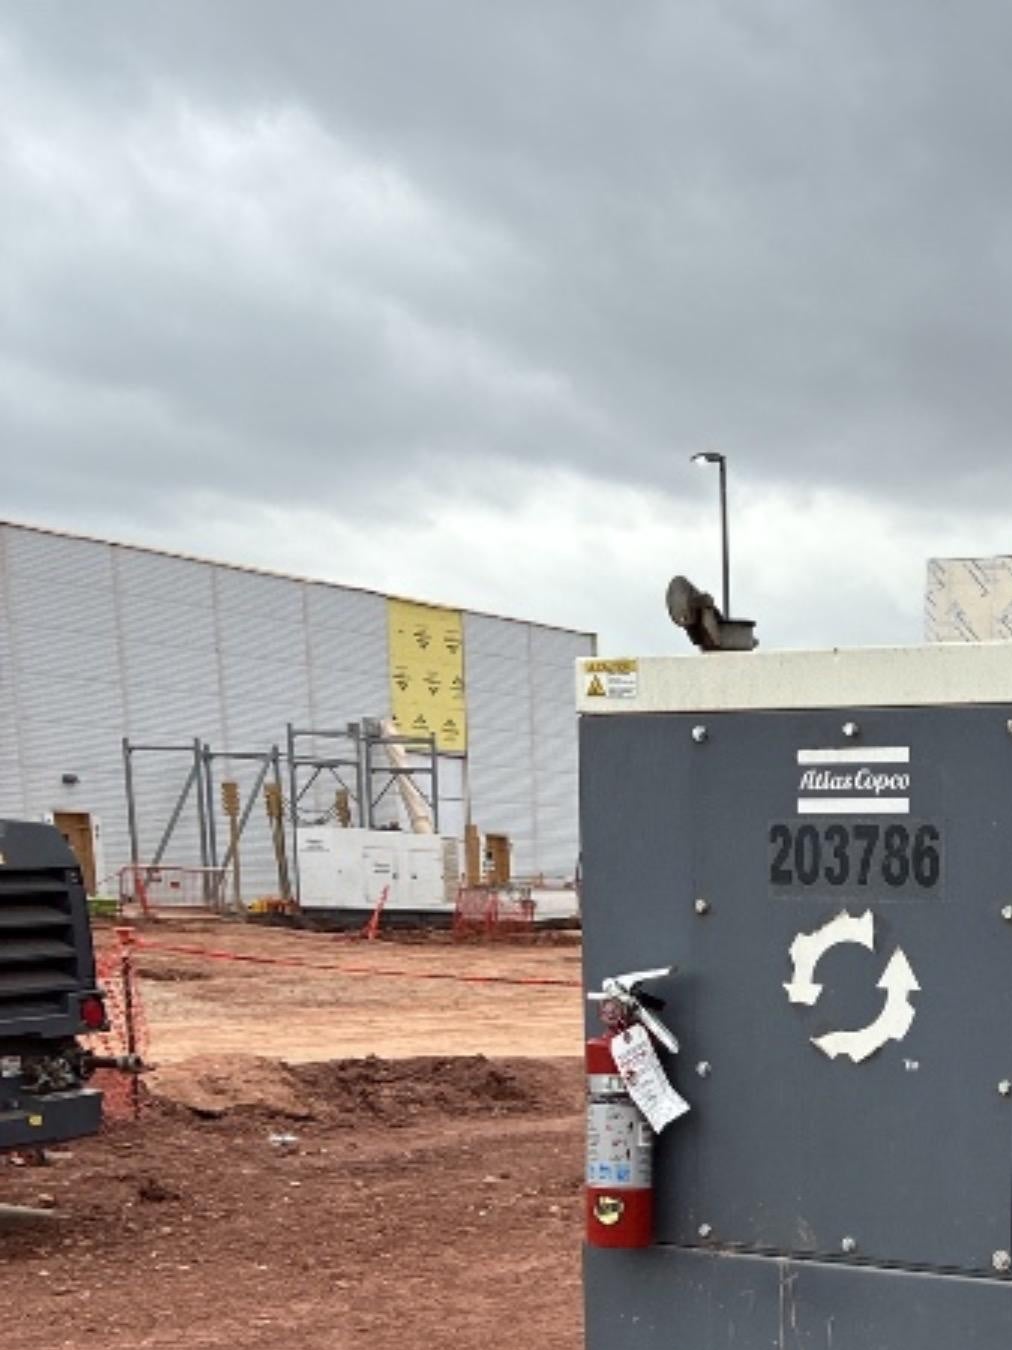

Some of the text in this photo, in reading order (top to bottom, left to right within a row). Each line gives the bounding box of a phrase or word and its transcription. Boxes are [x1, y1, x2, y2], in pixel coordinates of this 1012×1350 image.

[799, 768, 911, 795] Atlas Copco
[769, 823, 941, 888] 203786
